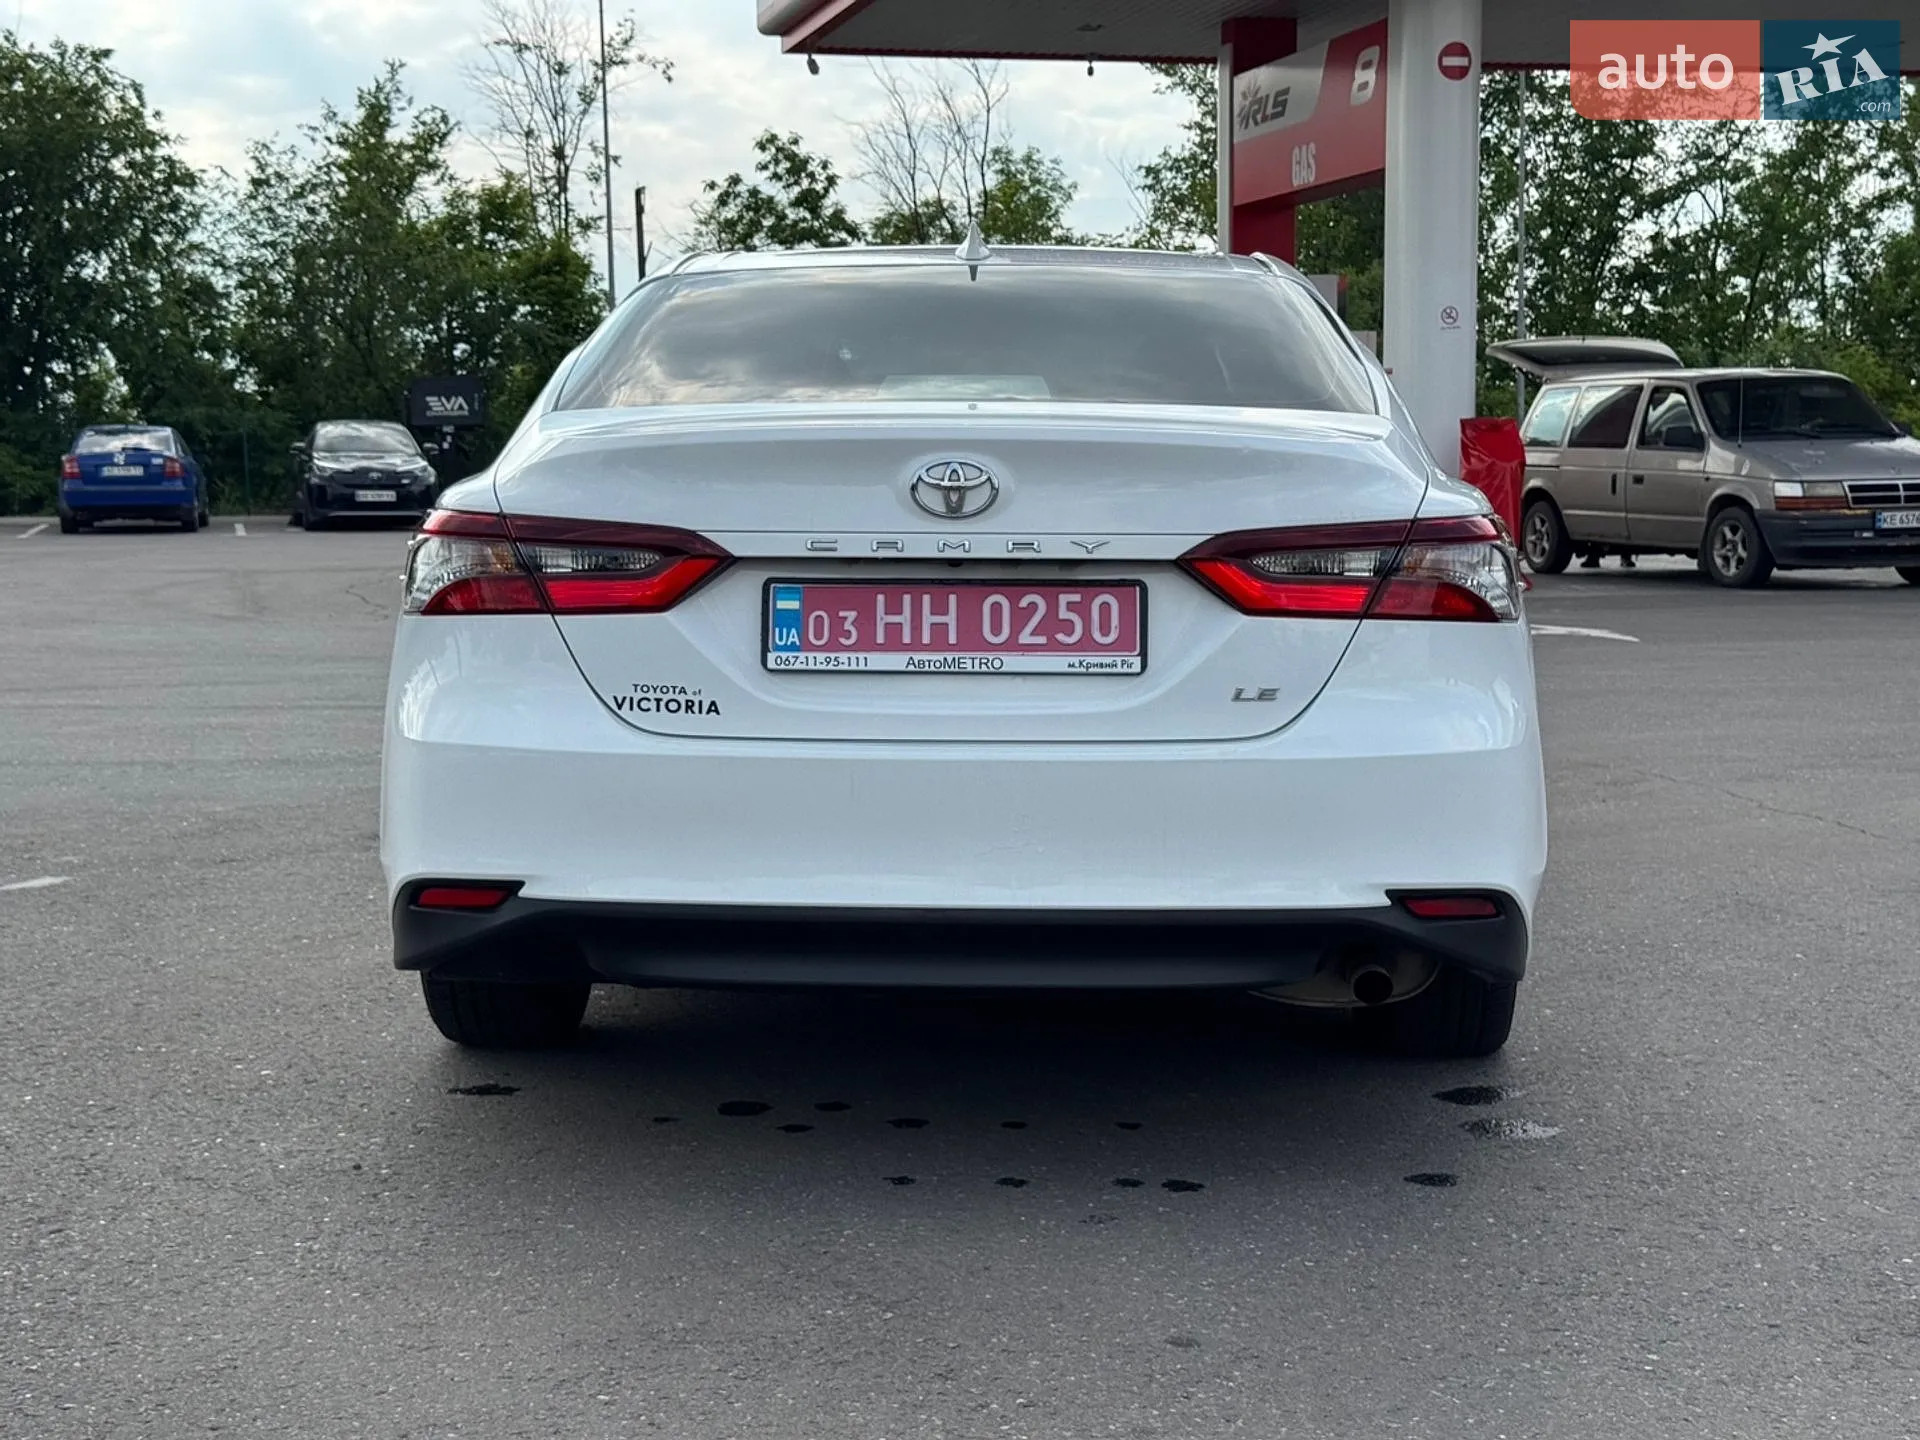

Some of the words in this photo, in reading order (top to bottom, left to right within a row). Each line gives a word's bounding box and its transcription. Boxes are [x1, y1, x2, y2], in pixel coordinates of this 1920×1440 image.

[1350, 44, 1381, 107] 8
[1291, 142, 1317, 187] GAS
[425, 395, 469, 411] EVA
[805, 538, 1110, 554] CAMRY
[808, 610, 858, 646] 03
[876, 593, 958, 645] HH
[982, 593, 1120, 645] 0250
[775, 627, 800, 647] UA
[774, 655, 869, 668] 067-11-95-111
[632, 683, 688, 696] TOYOTA
[1230, 687, 1281, 702] LE
[613, 695, 721, 716] VICTORIA
